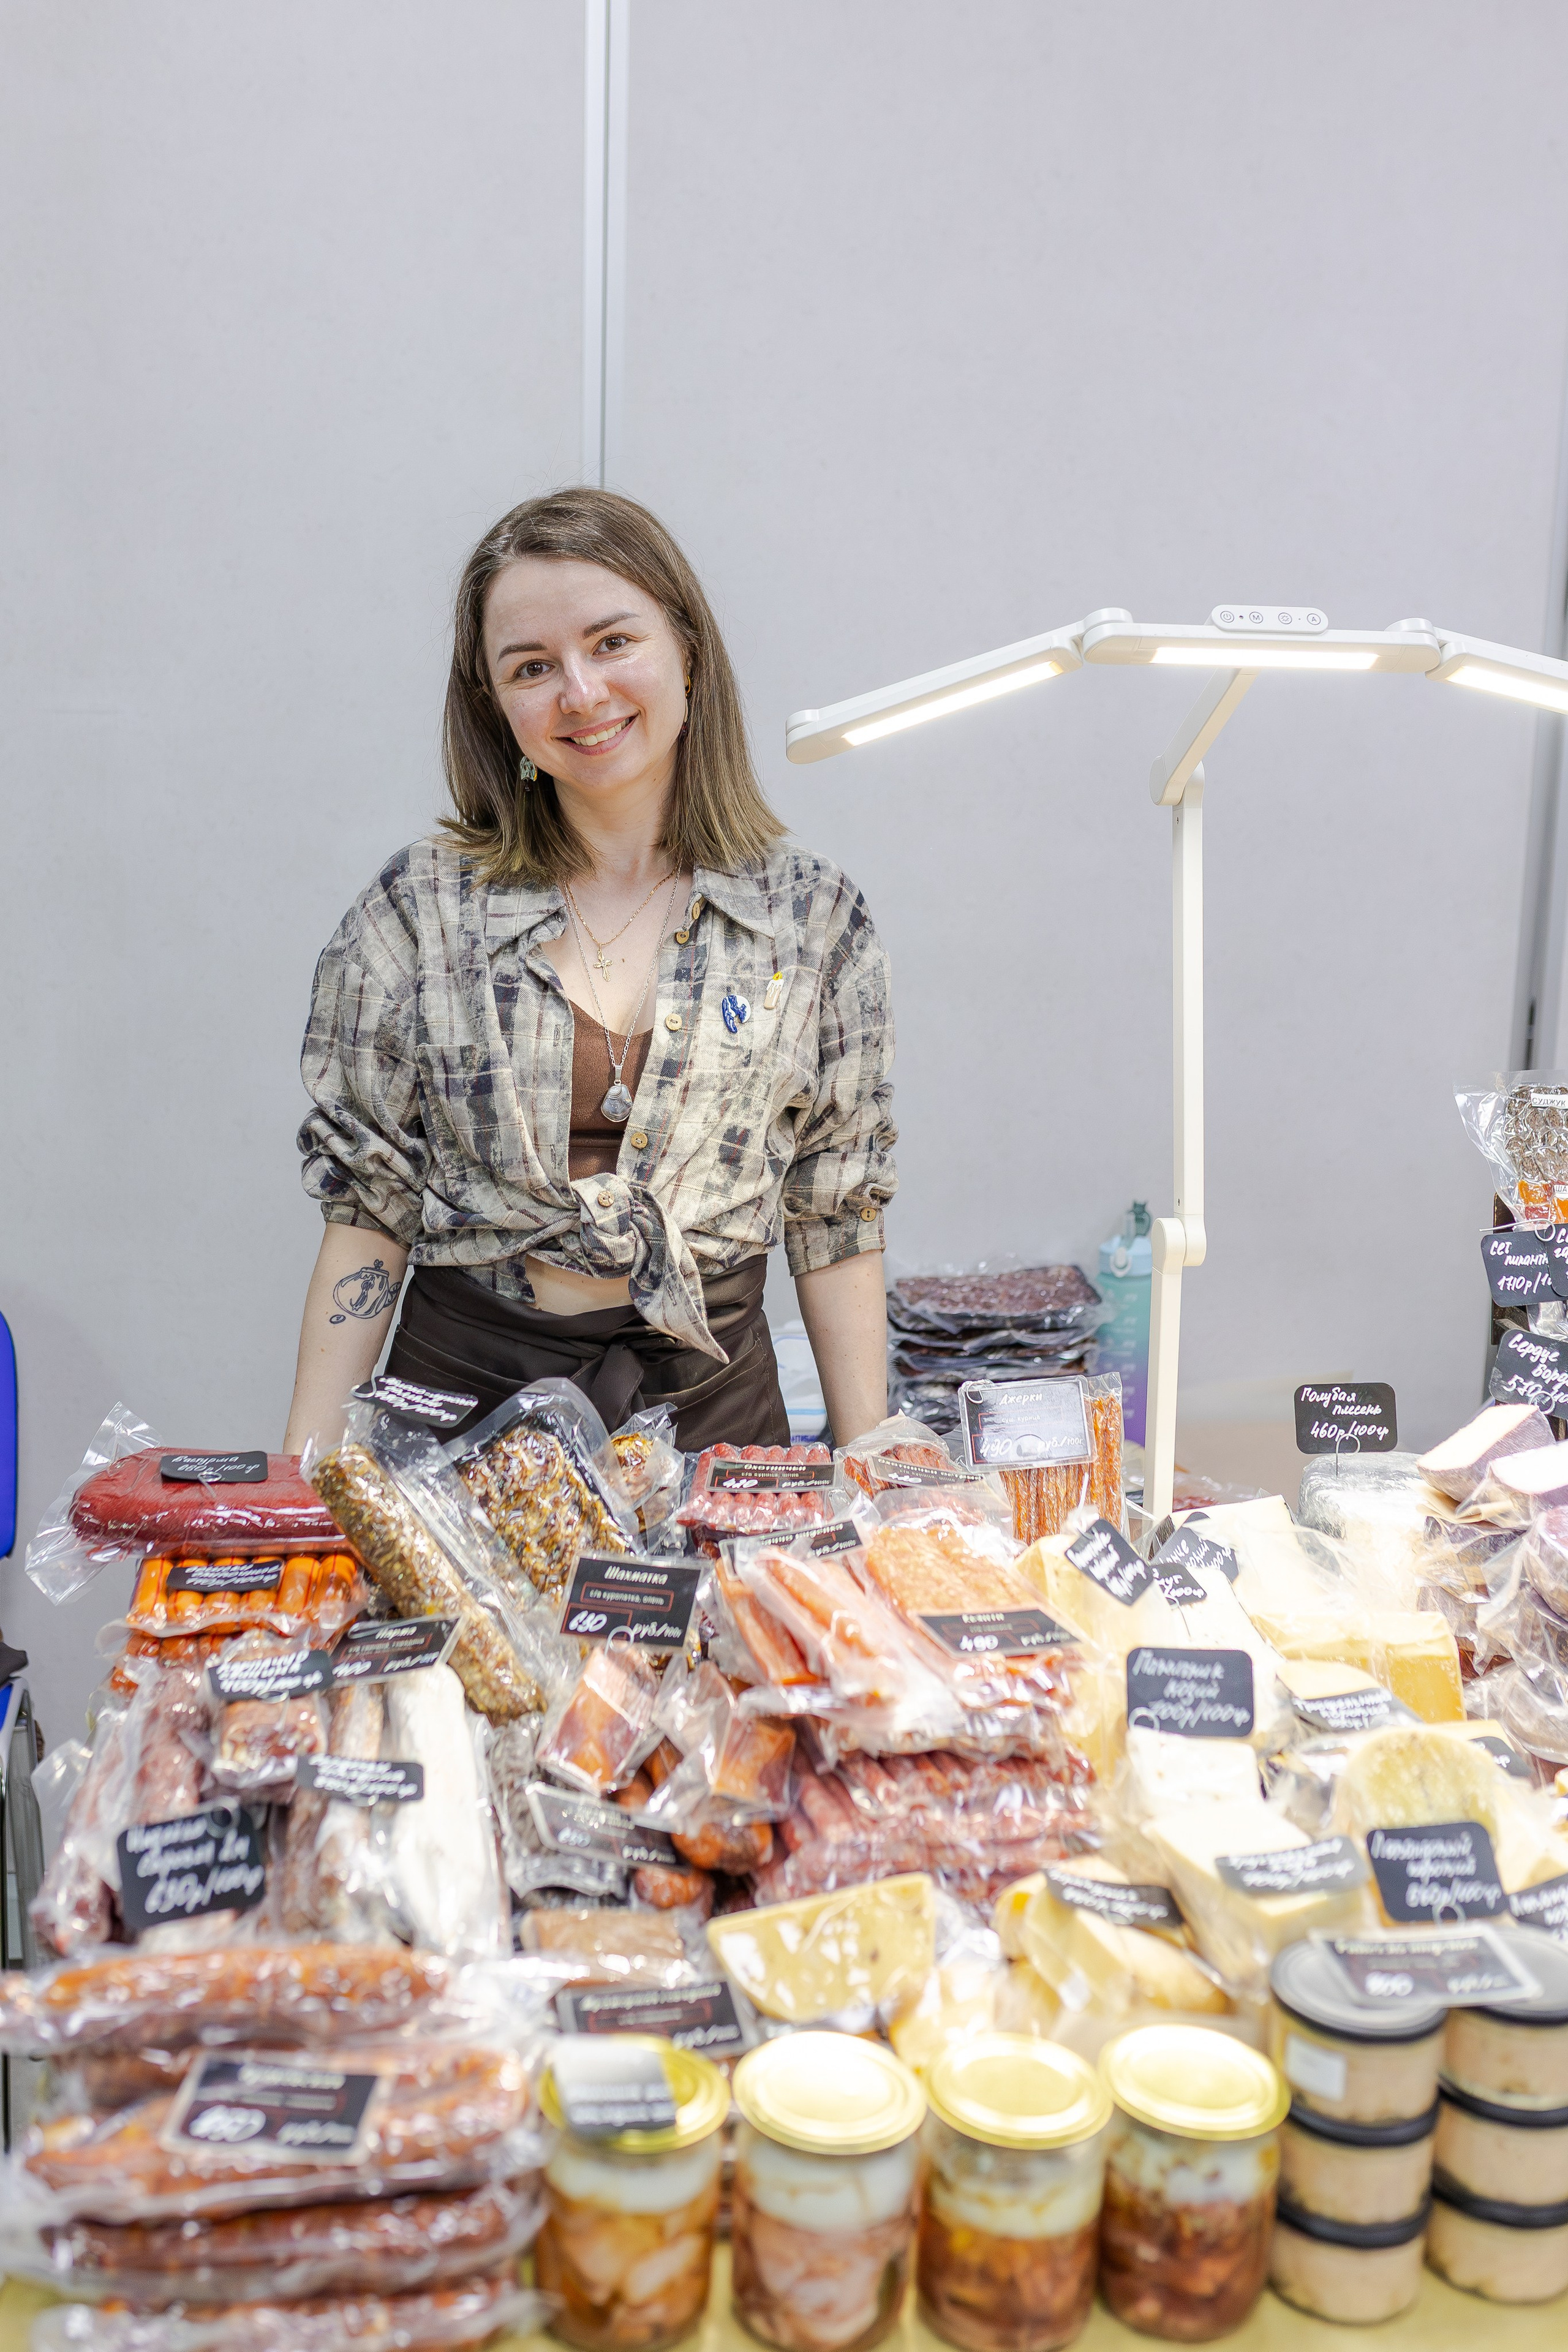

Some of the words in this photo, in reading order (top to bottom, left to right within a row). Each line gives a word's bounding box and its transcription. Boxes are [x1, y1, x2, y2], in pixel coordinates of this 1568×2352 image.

[1532, 1096, 1566, 1107] СУДЖУК
[998, 1392, 1043, 1406] Джерки
[1301, 1387, 1356, 1408] Голубая
[1332, 1404, 1382, 1415] плесень
[1310, 1420, 1389, 1441] 460р/100гр
